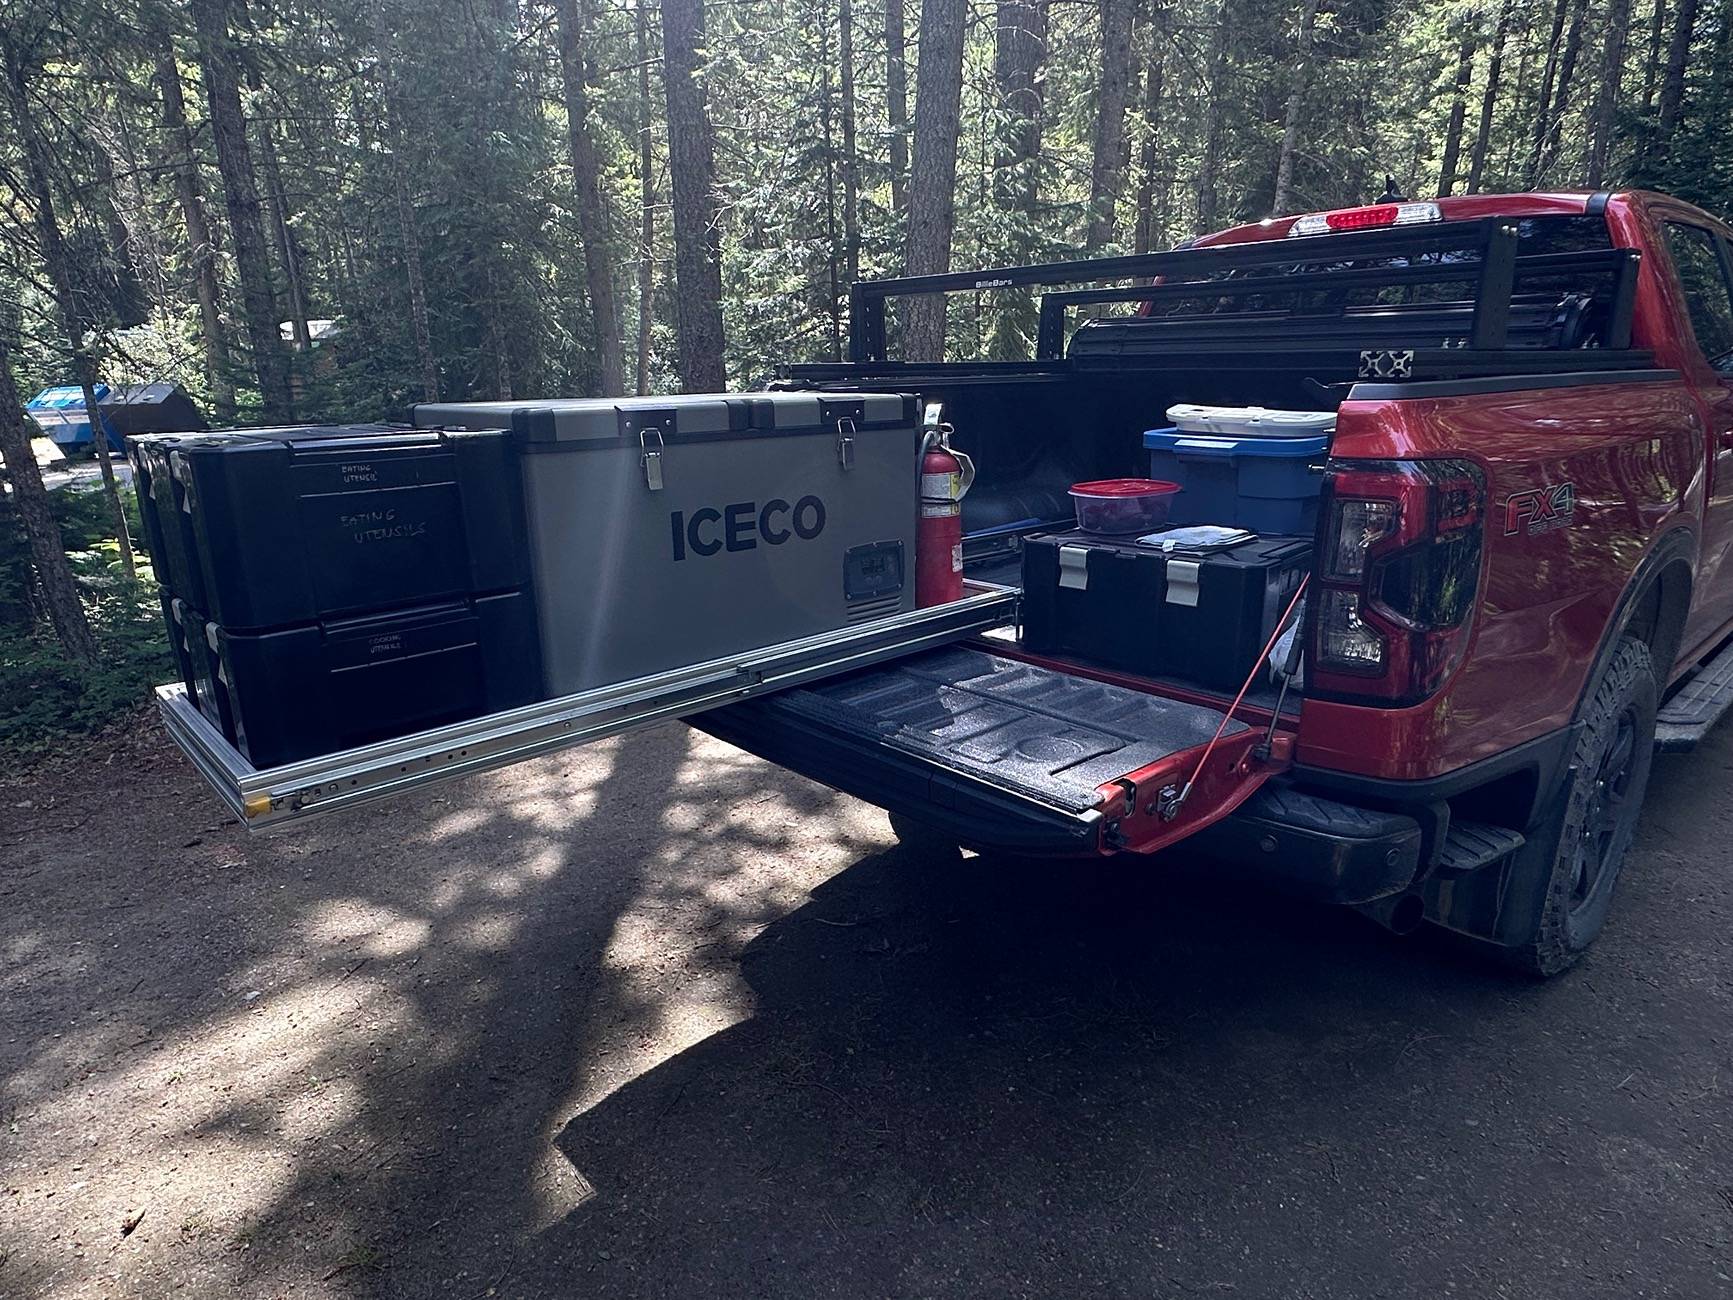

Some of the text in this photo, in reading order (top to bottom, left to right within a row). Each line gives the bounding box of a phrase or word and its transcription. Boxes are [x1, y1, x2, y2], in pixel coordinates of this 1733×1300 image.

[341, 464, 372, 473] EATING
[340, 508, 396, 528] EATING
[1503, 481, 1574, 536] FX4
[354, 522, 426, 544] UTENSILS
[670, 495, 826, 562] ICECO
